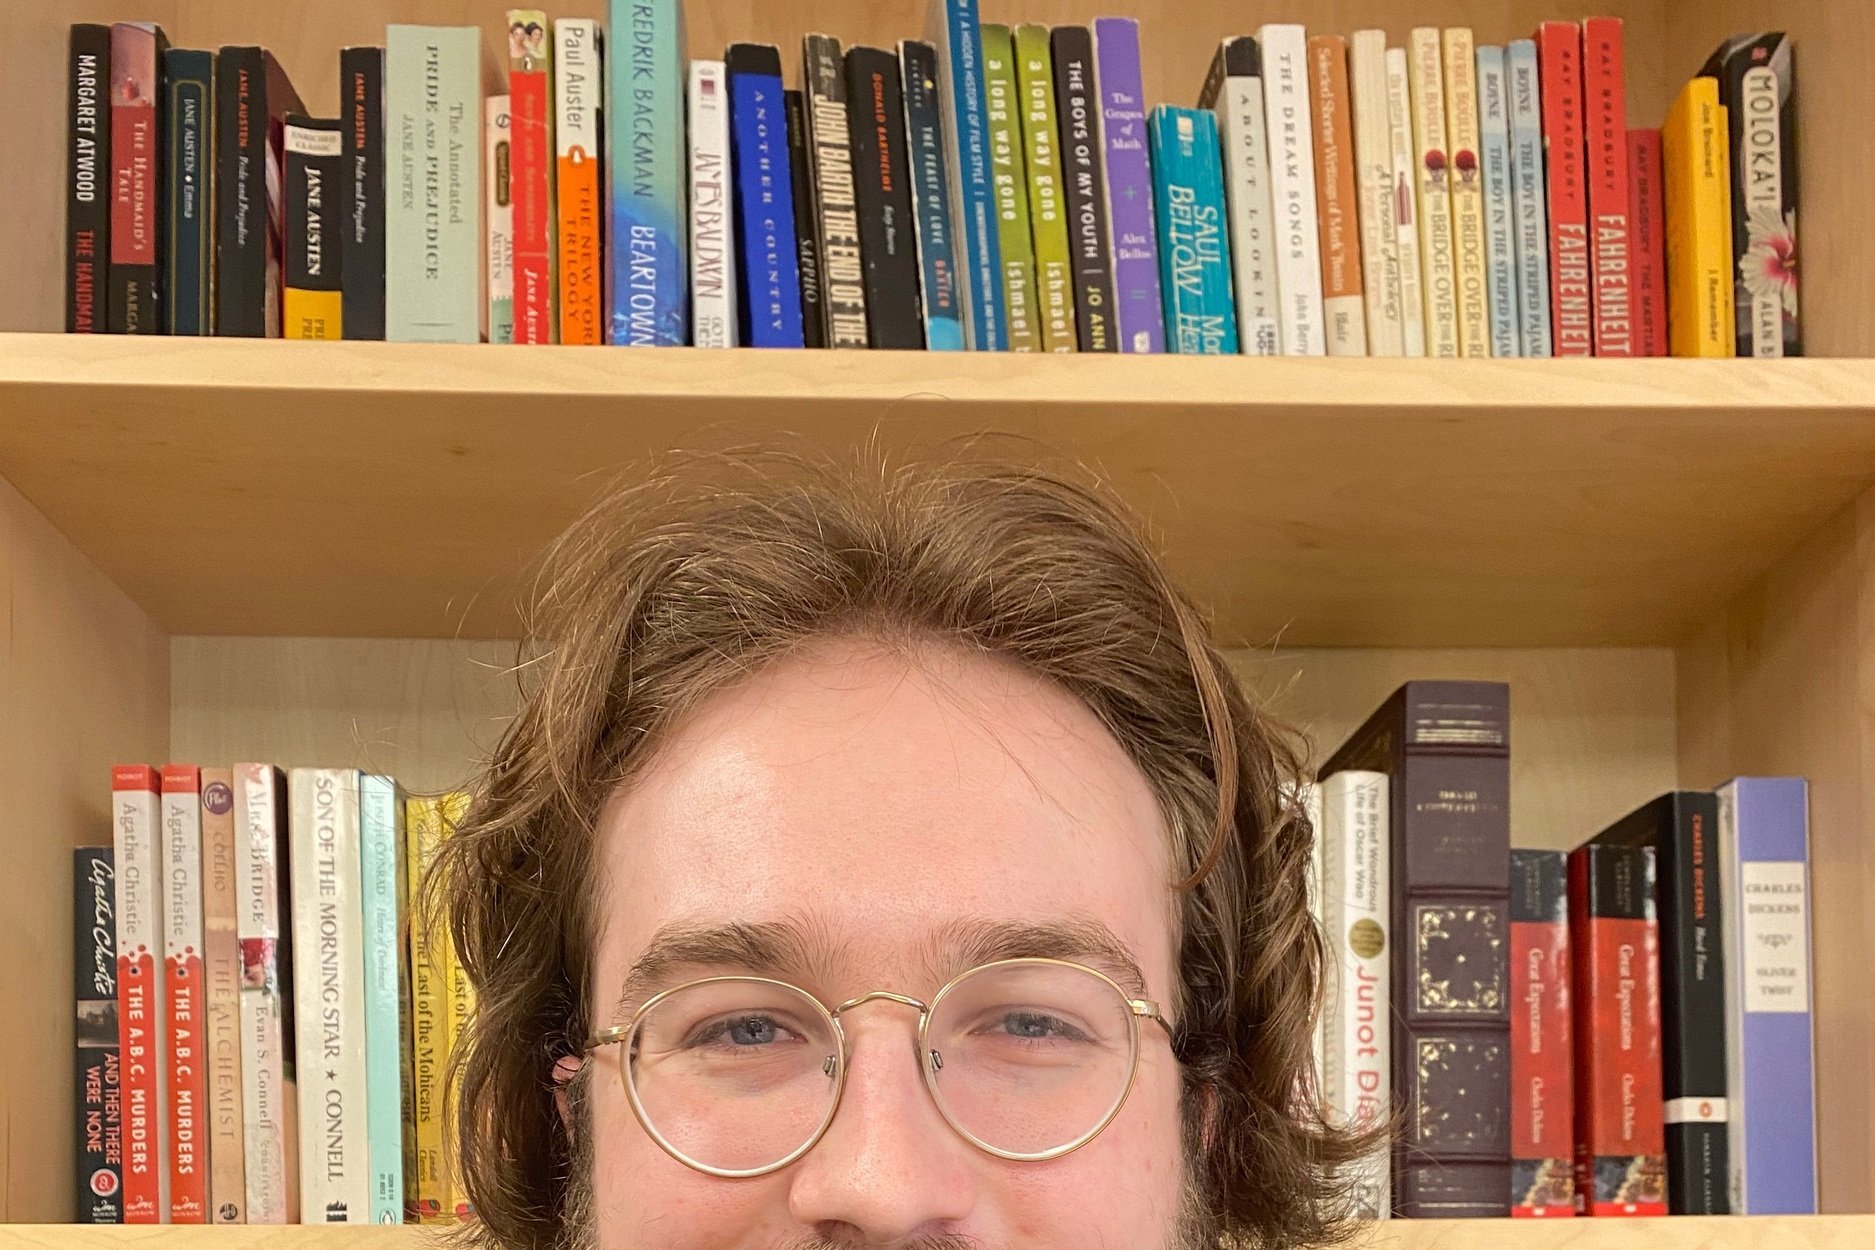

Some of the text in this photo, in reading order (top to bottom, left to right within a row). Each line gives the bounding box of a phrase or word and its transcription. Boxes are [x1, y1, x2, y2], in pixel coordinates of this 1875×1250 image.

[426, 45, 440, 112] PRIDE
[564, 26, 585, 129] Paul Auster
[815, 95, 849, 145] JOHN
[1279, 53, 1294, 95] THE
[75, 55, 97, 201] MARGARET ATWOOD
[448, 103, 464, 224] The Annotated
[632, 87, 657, 198] BACKMAN
[694, 146, 723, 206] JAMES
[818, 148, 853, 205] BARTH
[1240, 95, 1257, 188] ABOUT
[1283, 107, 1298, 179] DREAM
[1602, 89, 1615, 190] BRADBURY
[1749, 75, 1774, 201] MOLOKA'I
[305, 165, 321, 276] JANE AUSTEN
[426, 156, 440, 281] PREJUDICE
[755, 91, 782, 331] ANOTHER COUNTRY
[825, 210, 855, 241] THE
[989, 60, 1030, 336] a long way gone ishmael
[1029, 61, 1070, 337] a long way gone ishmael
[1068, 60, 1106, 349] THE BOYS OF MY YOUTH JO ANN
[1167, 184, 1202, 295] BELLOW
[1192, 206, 1218, 264] SAUL
[1287, 190, 1304, 261] SONGS
[629, 225, 656, 345] BEARTOWN
[694, 208, 723, 299] BALDWIN
[799, 238, 818, 303] SAPPHO
[827, 245, 858, 280] END
[830, 285, 861, 307] OF
[1432, 214, 1452, 321] BRIDGE OVER
[1596, 215, 1629, 353] FAHRENHEIT
[834, 312, 866, 344] THE
[120, 803, 141, 935] Agatha Christie
[168, 805, 189, 936] Agatha Christie
[251, 847, 268, 924] BRIDGE
[1366, 788, 1380, 912] The Brief Wondrous
[1745, 883, 1801, 894] CHARLES
[90, 858, 116, 996] Agatha Christie
[1748, 904, 1800, 914] DICKENS
[174, 986, 191, 1022] THE
[315, 779, 344, 1183] SON OF THE MORNING STAR CONNELL
[1354, 965, 1380, 1057] Junot
[1757, 967, 1796, 977] OLIVER
[1759, 984, 1793, 995] TWIST
[127, 985, 147, 1175] THE A.B.C. MURDERS
[176, 1028, 192, 1082] A.B.C.
[215, 957, 236, 1140] THE ALCHEMIST
[256, 1006, 273, 1130] Evan S. Connell
[417, 963, 436, 1123] Last of the Mohicans
[1616, 945, 1635, 1140] Great Expectations Charles Dickens
[86, 1065, 102, 1152] WERE NONE
[103, 1053, 121, 1164] AND THEN THERE
[177, 1089, 194, 1176] MURDERS
